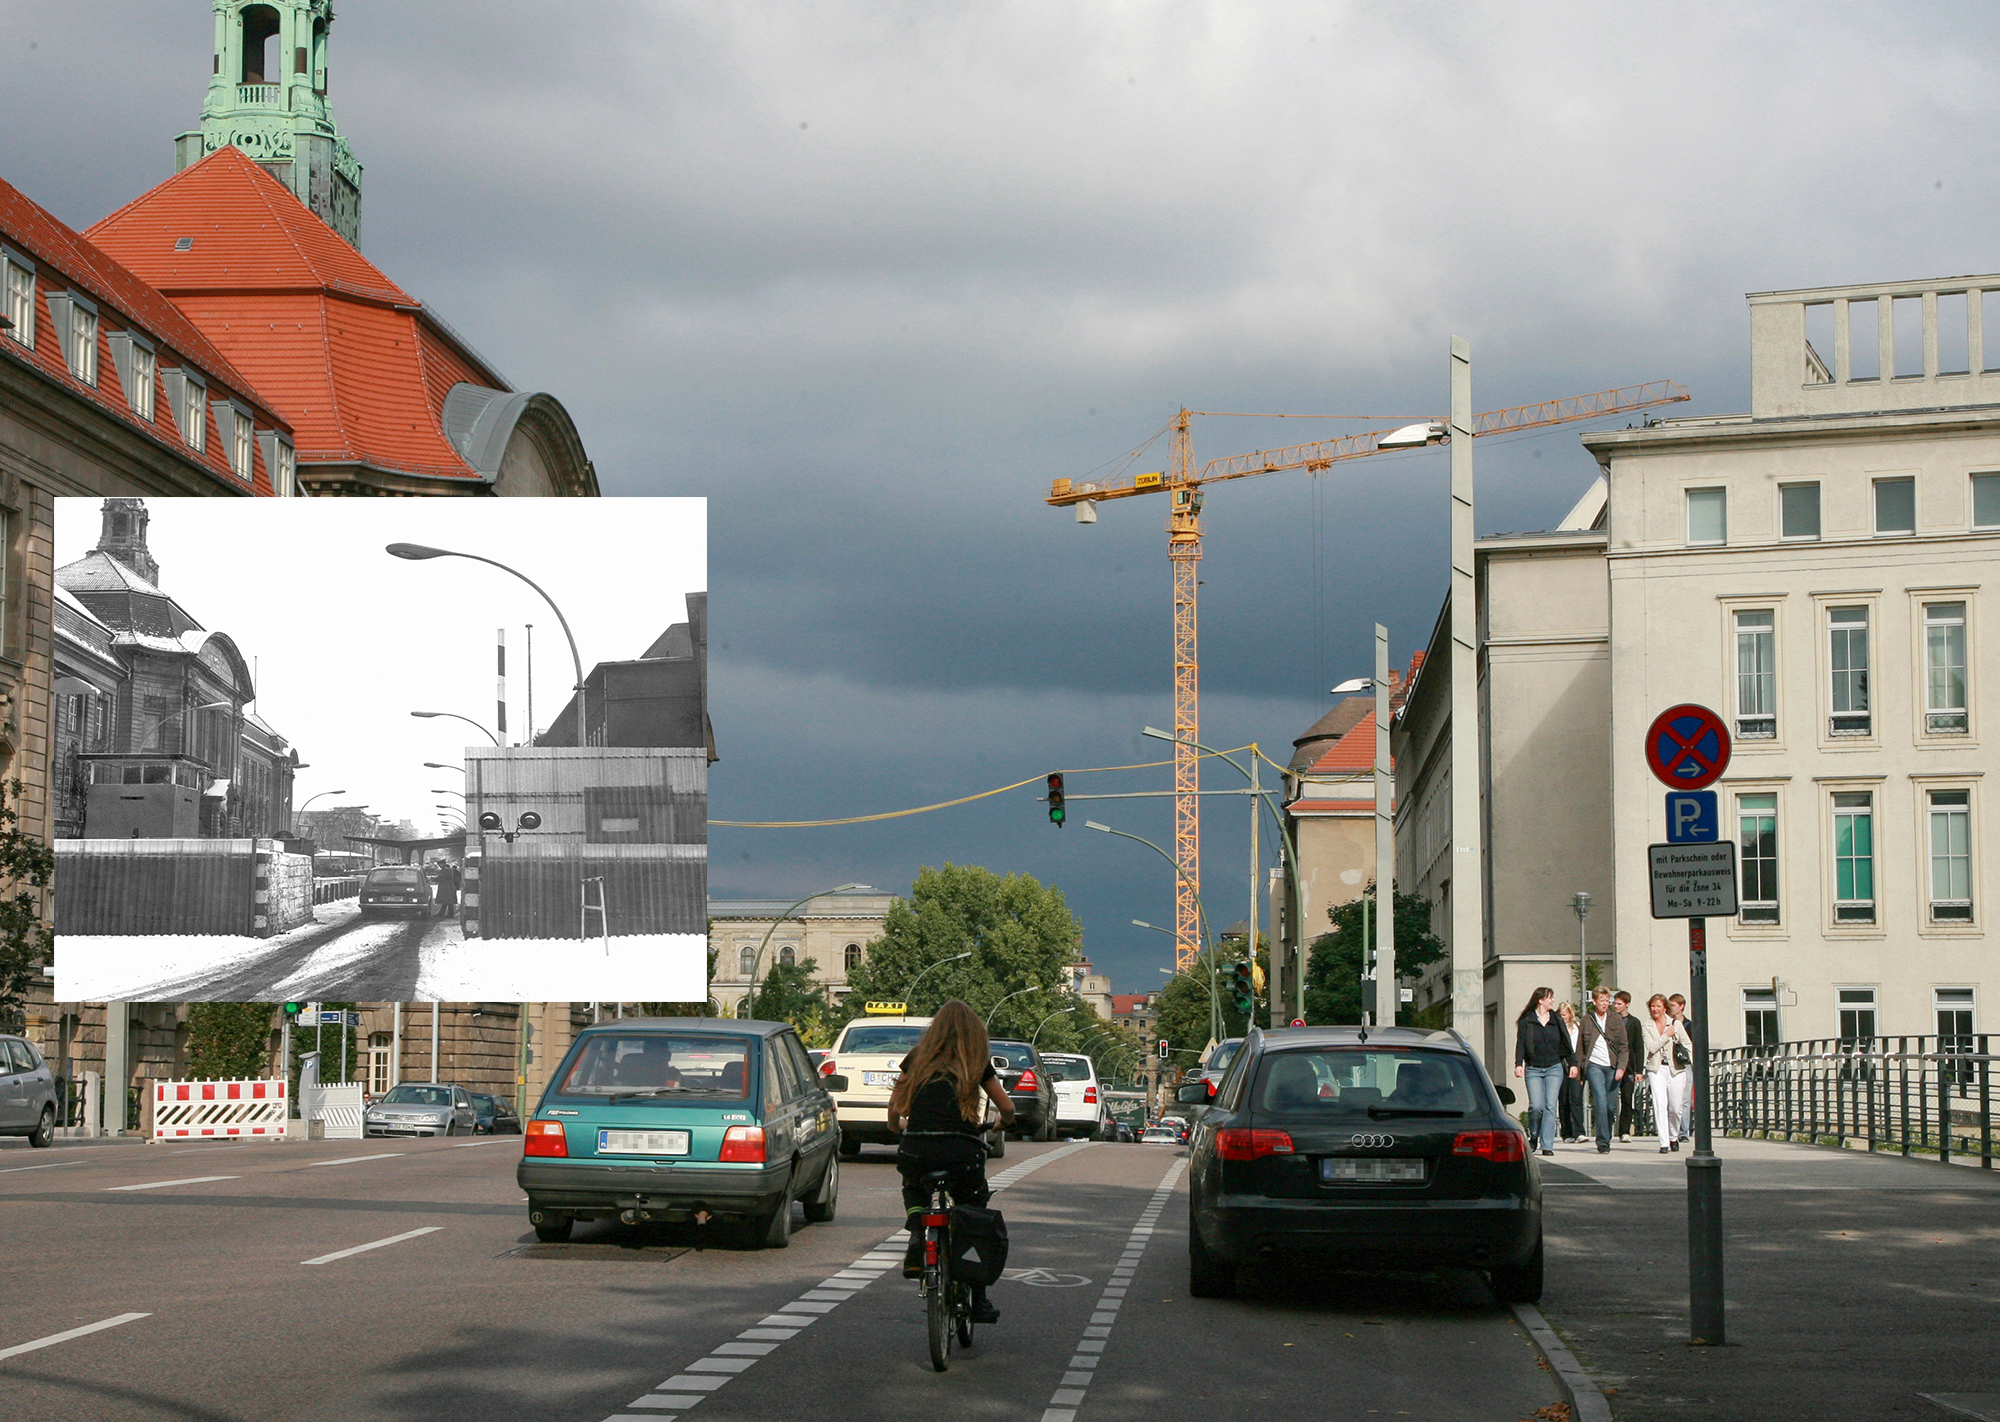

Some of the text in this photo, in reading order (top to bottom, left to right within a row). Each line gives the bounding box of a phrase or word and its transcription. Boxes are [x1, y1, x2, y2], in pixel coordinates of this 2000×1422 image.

[1675, 799, 1701, 837] P
[1656, 852, 1727, 864] mit Parkschein oder
[1654, 867, 1731, 879] Bewohnerparkausweis
[1665, 882, 1721, 893] für die Zone 34
[306, 1060, 313, 1069] P
